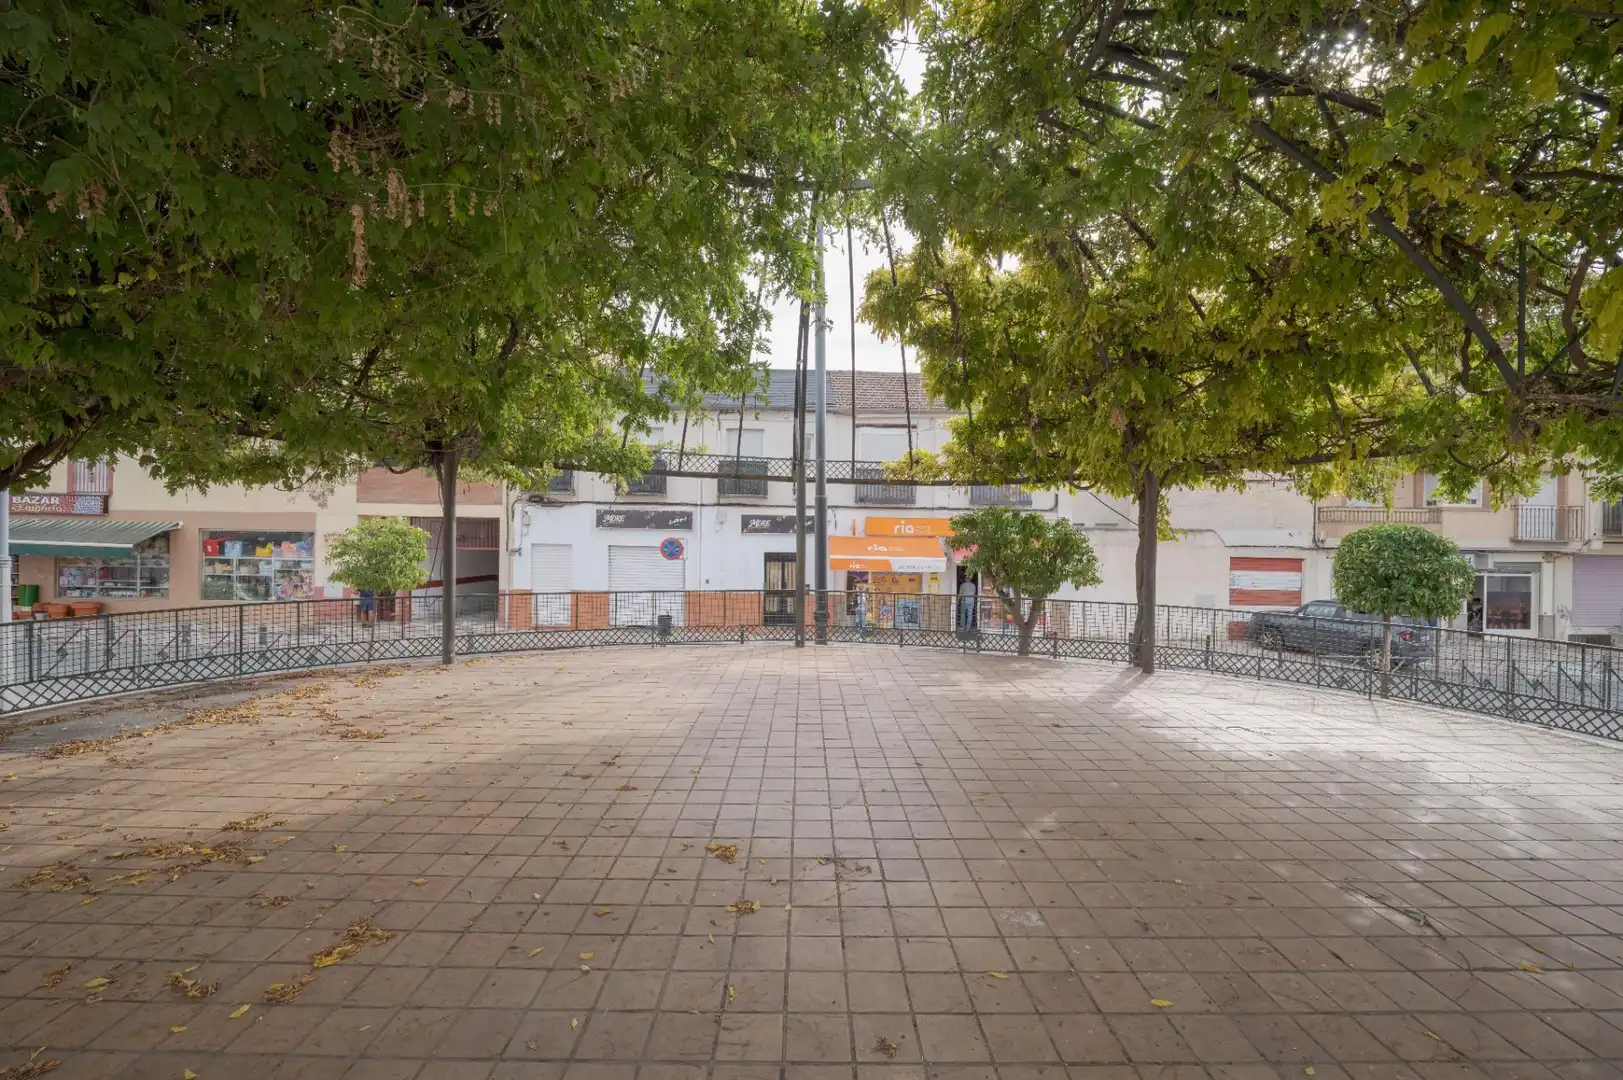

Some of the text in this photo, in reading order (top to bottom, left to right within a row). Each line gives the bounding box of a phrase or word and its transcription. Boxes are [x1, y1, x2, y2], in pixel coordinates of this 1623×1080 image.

[12, 495, 60, 504] BAZAR
[893, 520, 915, 534] ria
[867, 544, 888, 552] ria
